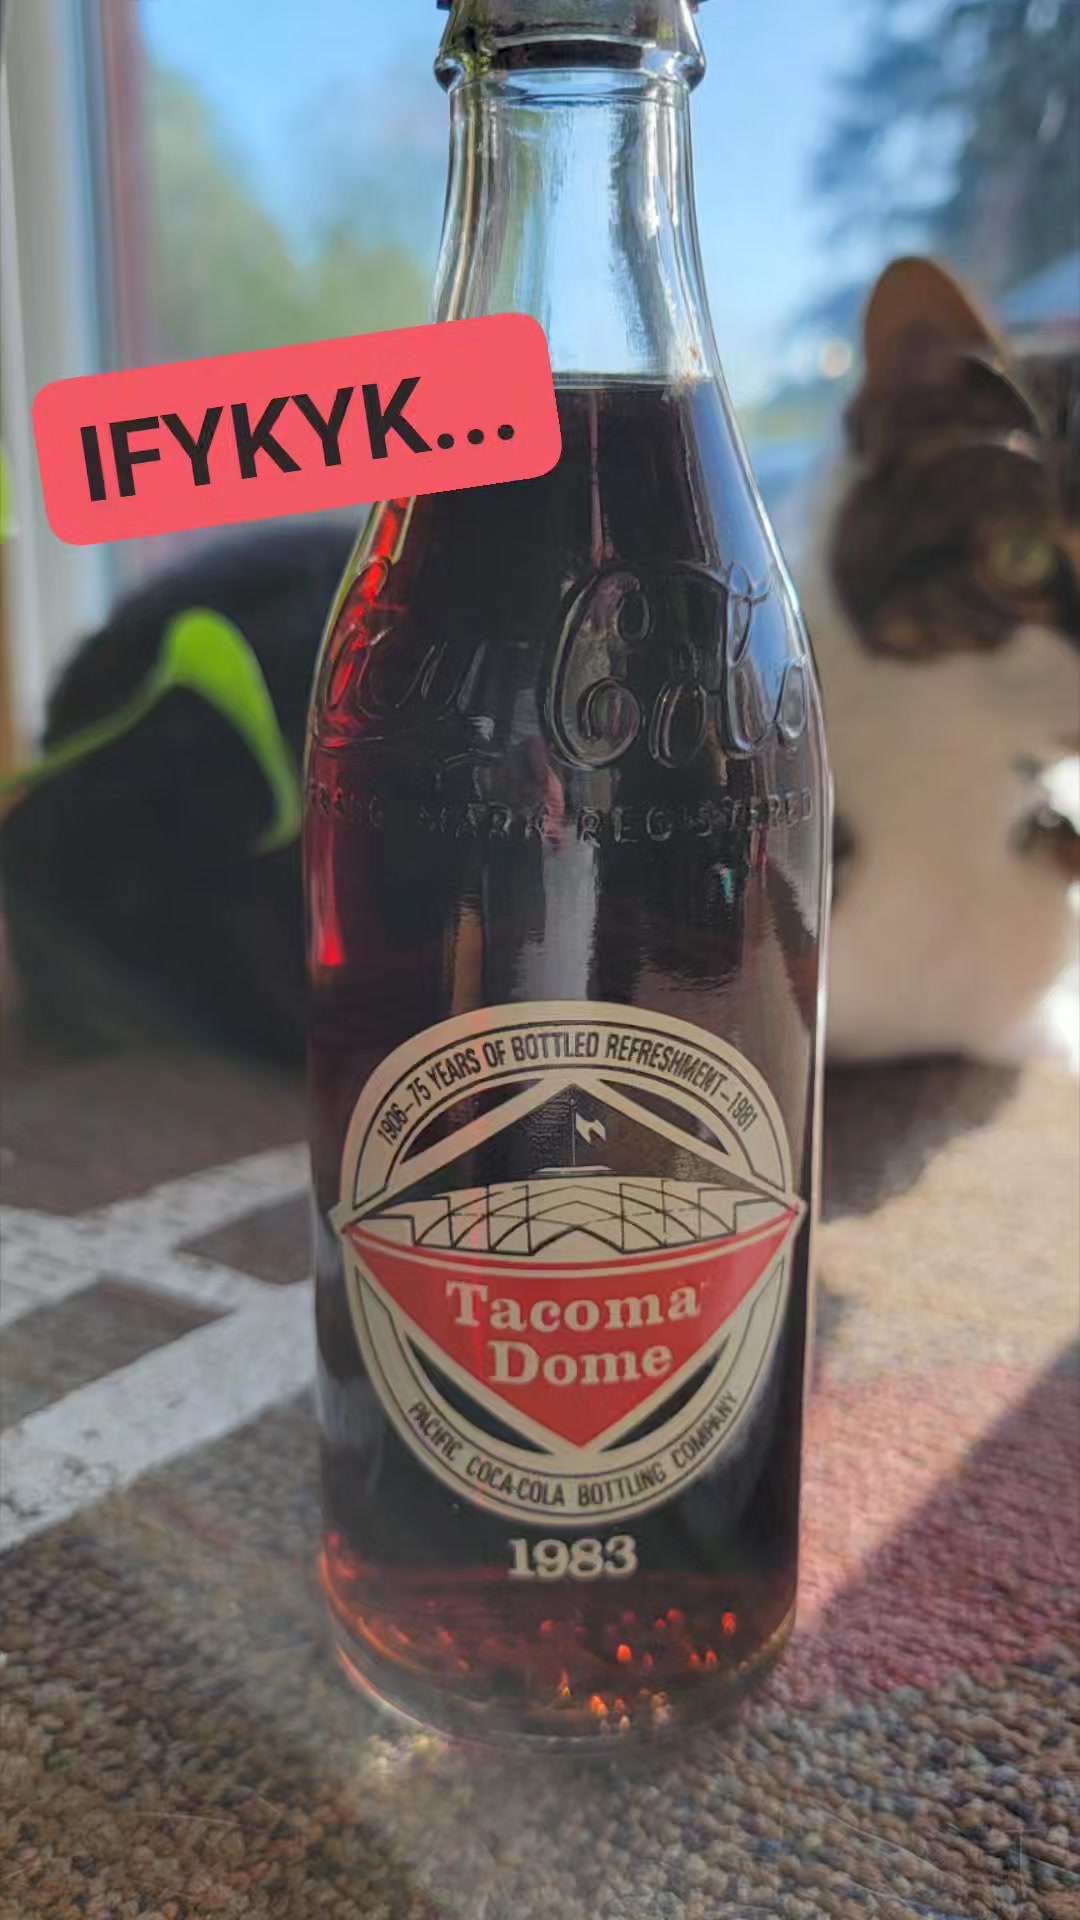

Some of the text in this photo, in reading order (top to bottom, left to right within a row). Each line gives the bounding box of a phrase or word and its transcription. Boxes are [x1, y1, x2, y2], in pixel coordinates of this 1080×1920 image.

[425, 1047, 481, 1090] YEARS
[482, 1039, 506, 1068] OF
[511, 1031, 599, 1062] BOTTLED
[446, 1280, 700, 1332] Tacoma
[487, 1340, 673, 1386] Dome
[407, 1401, 463, 1461] PACIFIC
[578, 1461, 666, 1507] BOTTLING
[671, 1390, 737, 1468] COMPANY
[508, 1535, 638, 1580] 1983
